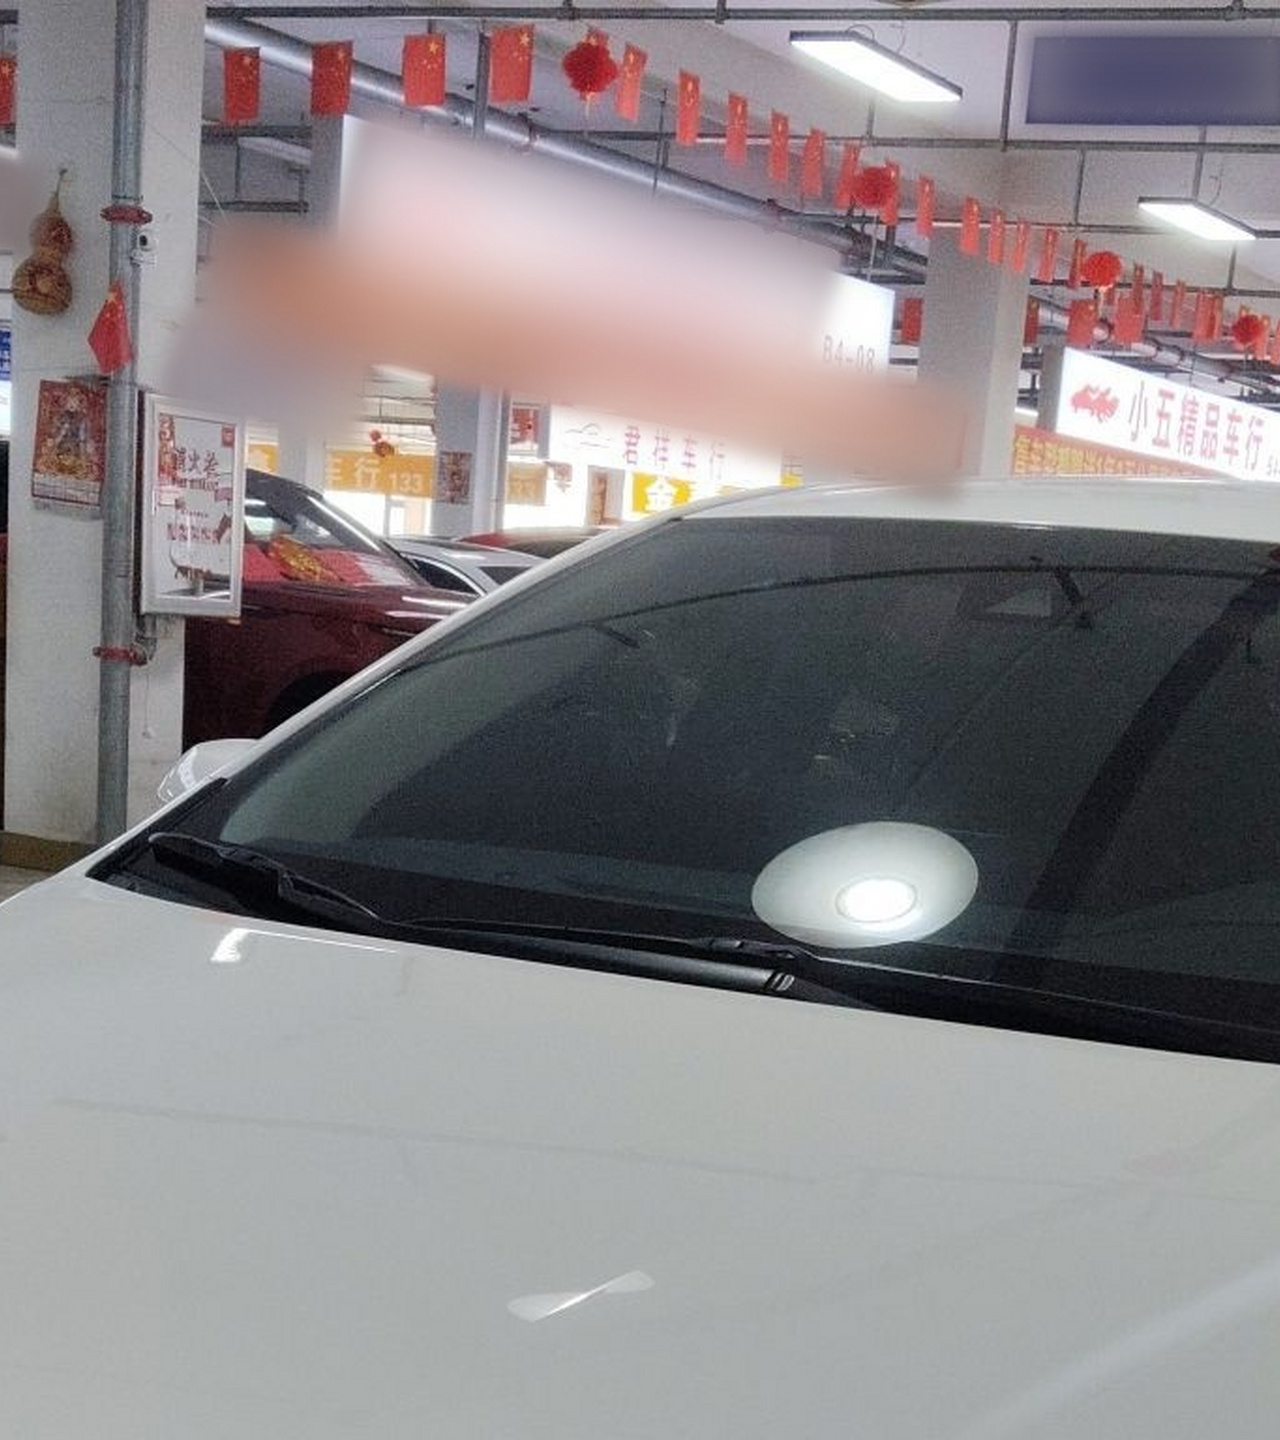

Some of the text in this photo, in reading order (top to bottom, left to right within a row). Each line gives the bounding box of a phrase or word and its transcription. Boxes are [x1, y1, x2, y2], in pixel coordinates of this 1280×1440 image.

[1128, 380, 1265, 472] 小五精品车行
